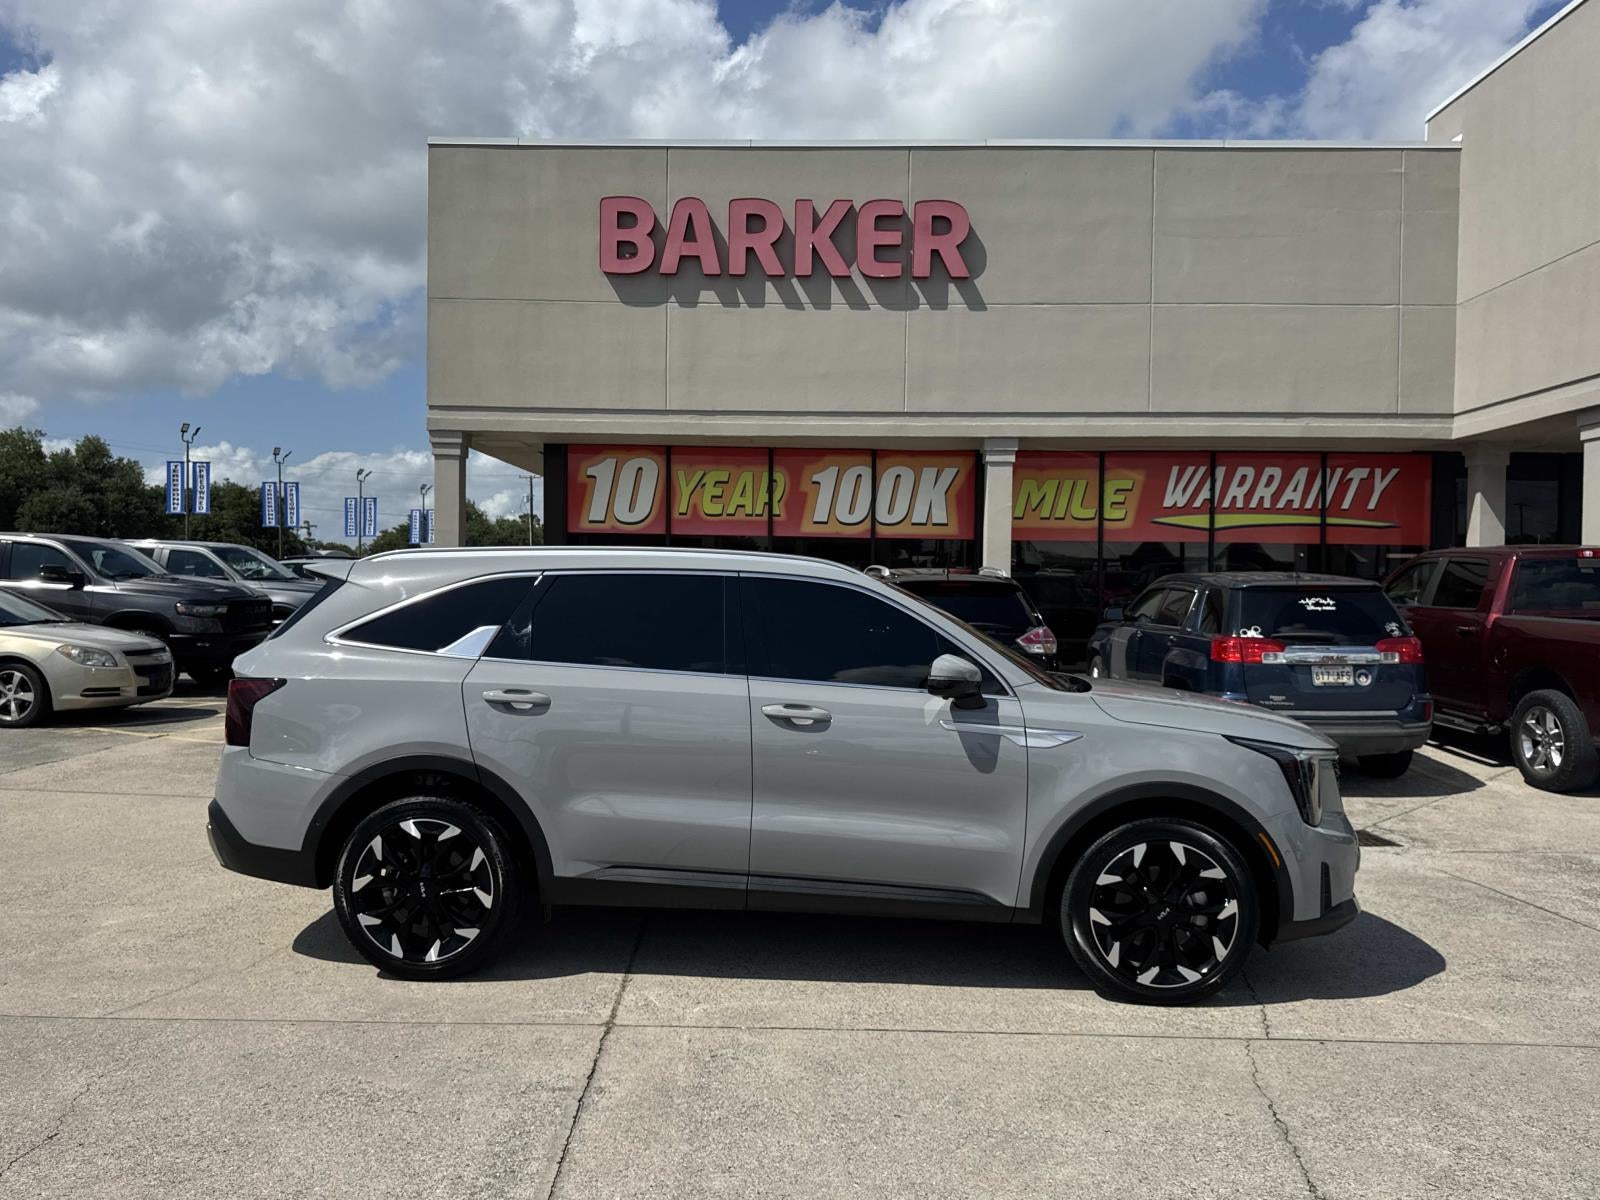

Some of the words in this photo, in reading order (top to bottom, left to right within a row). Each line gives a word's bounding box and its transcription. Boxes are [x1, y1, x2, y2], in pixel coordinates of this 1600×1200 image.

[600, 196, 970, 278] BARKER
[586, 457, 660, 525] 10
[675, 469, 786, 518] YEAR
[810, 465, 959, 526] 100K
[1012, 478, 1135, 522] MILE
[1162, 464, 1400, 511] WARRANTY
